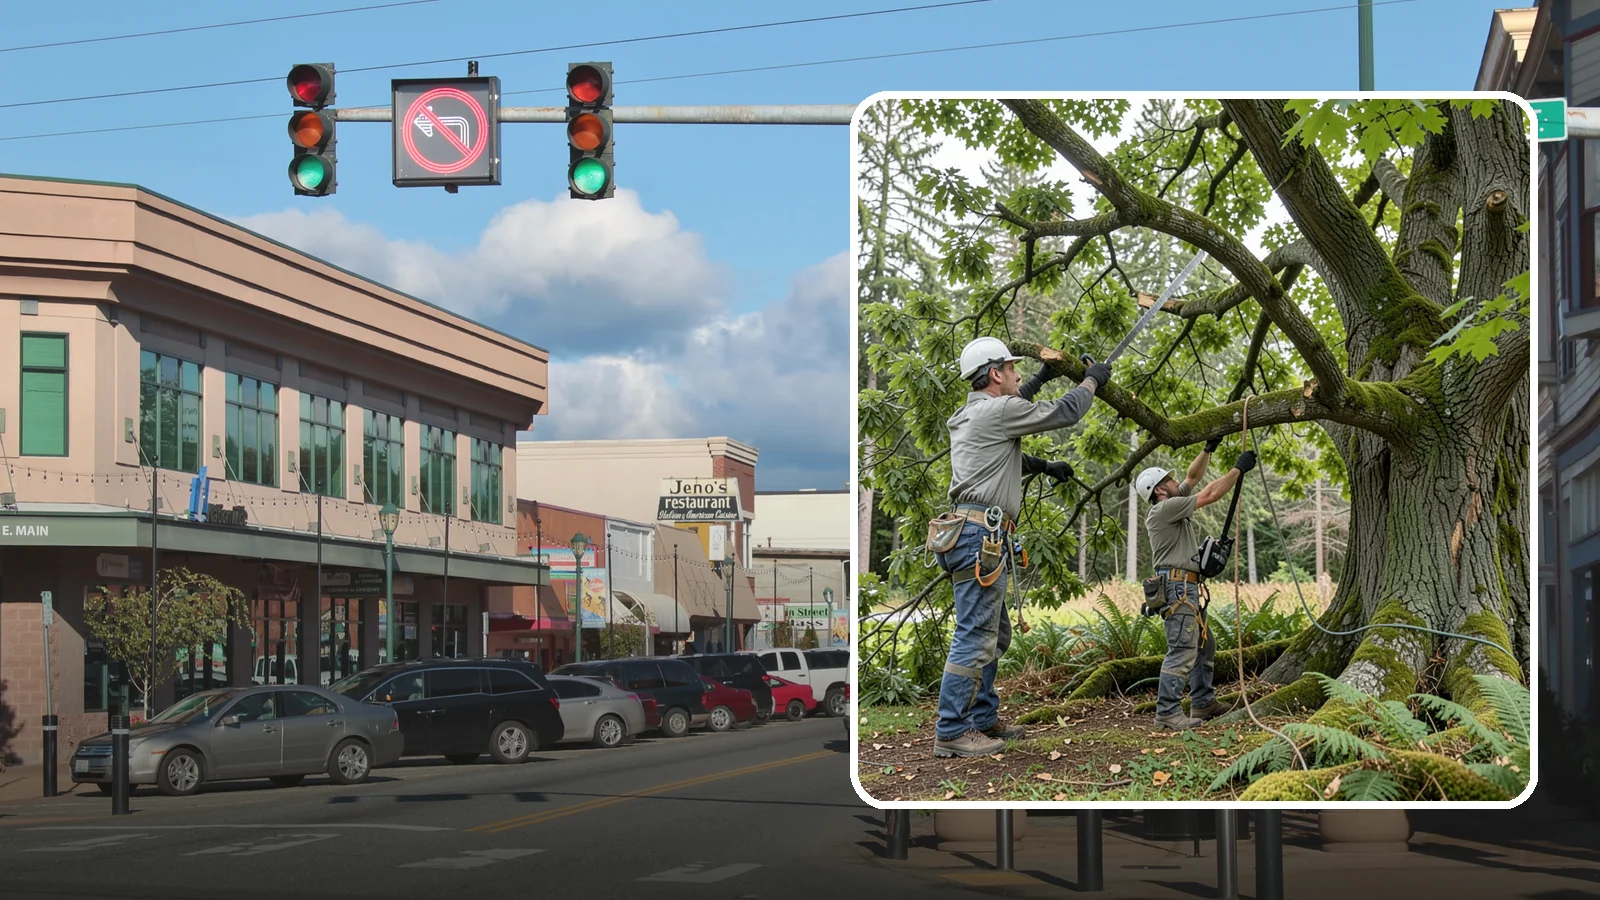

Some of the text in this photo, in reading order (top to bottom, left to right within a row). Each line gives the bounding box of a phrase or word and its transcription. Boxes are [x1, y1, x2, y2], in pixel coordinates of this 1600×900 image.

[670, 480, 727, 495] Jeno's
[665, 497, 731, 509] restaurant
[658, 510, 682, 520] Italian
[686, 510, 715, 520] American
[2, 525, 49, 536] E. MAIN
[797, 607, 828, 617] Street
